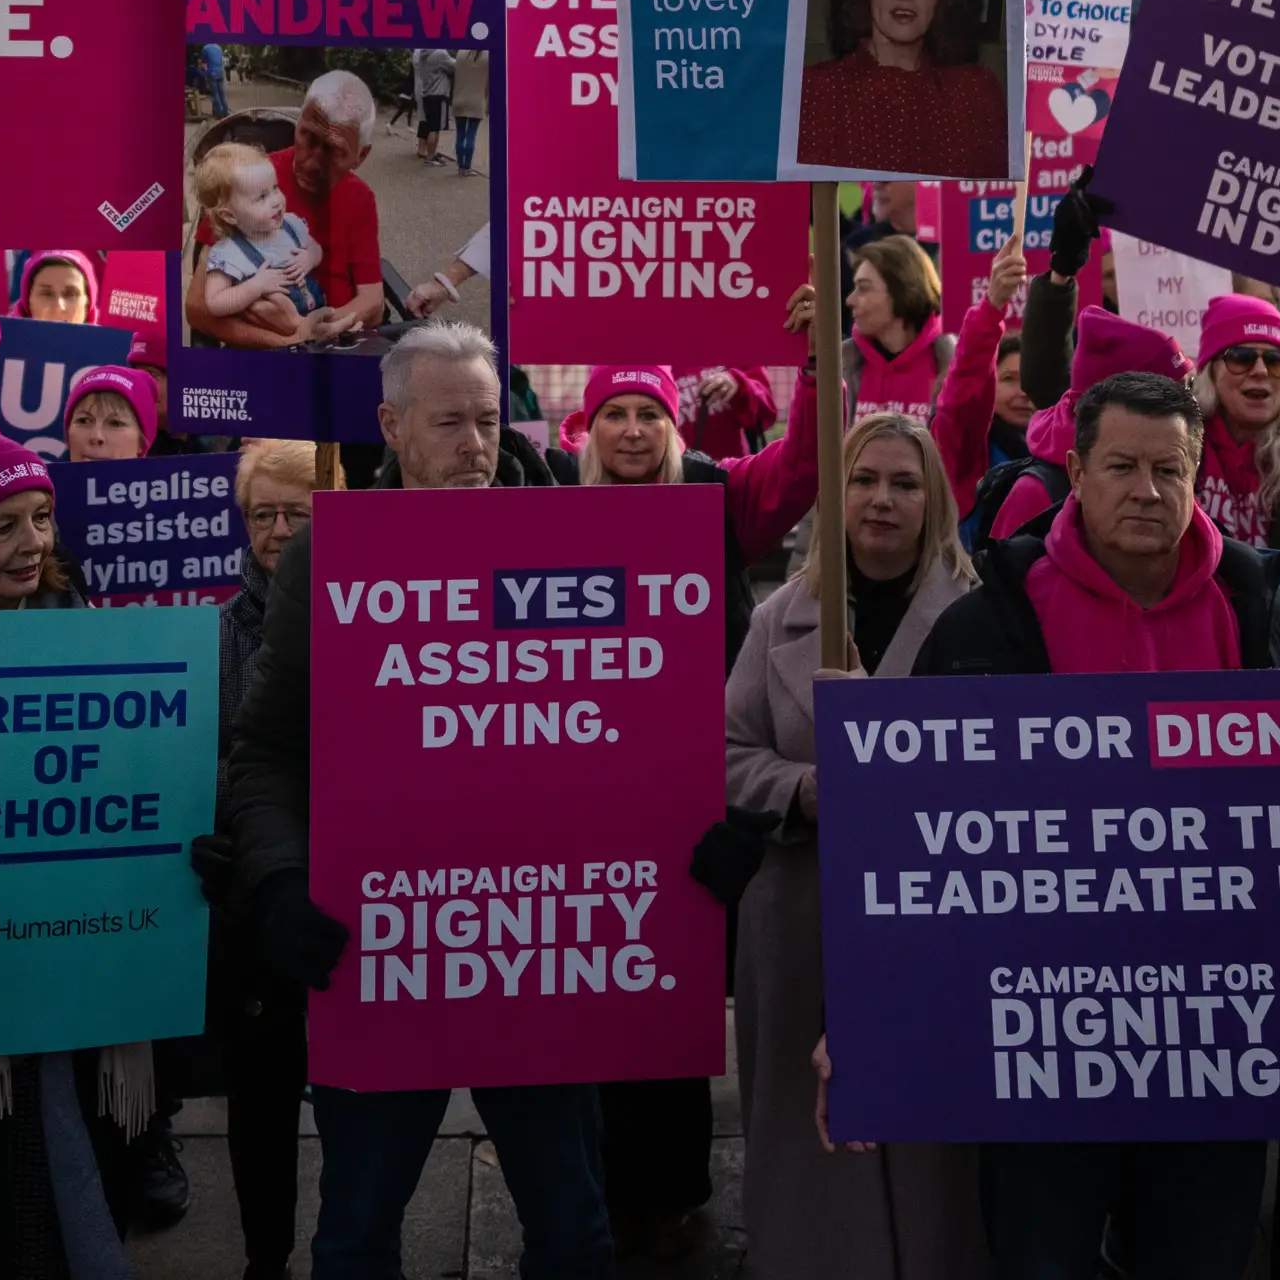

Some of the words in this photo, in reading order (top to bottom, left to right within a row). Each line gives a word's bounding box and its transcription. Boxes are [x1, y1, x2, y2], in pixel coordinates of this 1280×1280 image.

[1067, 1, 1131, 23] CHOICE
[654, 26, 741, 51] mum
[1034, 22, 1103, 42] DYING
[656, 60, 725, 90] Rita
[102, 204, 119, 222] YES
[116, 216, 130, 228] TO
[127, 184, 160, 219] DIGNITY
[1158, 277, 1184, 295] MY
[109, 305, 121, 315] IN
[122, 307, 157, 322] DYING.
[111, 295, 158, 311] DIGNITY
[0, 470, 29, 487] CHOOSE
[86, 472, 229, 509] Legalise
[86, 510, 229, 546] assisted
[182, 550, 242, 578] and
[326, 579, 480, 625] VOTE
[500, 575, 616, 620] YES
[637, 572, 710, 616] TO
[374, 636, 664, 688] ASSISTED
[422, 700, 620, 749] DYING.
[844, 719, 996, 764] VOTE
[1018, 715, 1134, 761] FOR
[33, 744, 100, 785] OF
[914, 809, 1070, 855] VOTE
[1091, 806, 1209, 854] FOR
[863, 865, 1257, 916] LEADBEATER
[128, 907, 159, 931] UK
